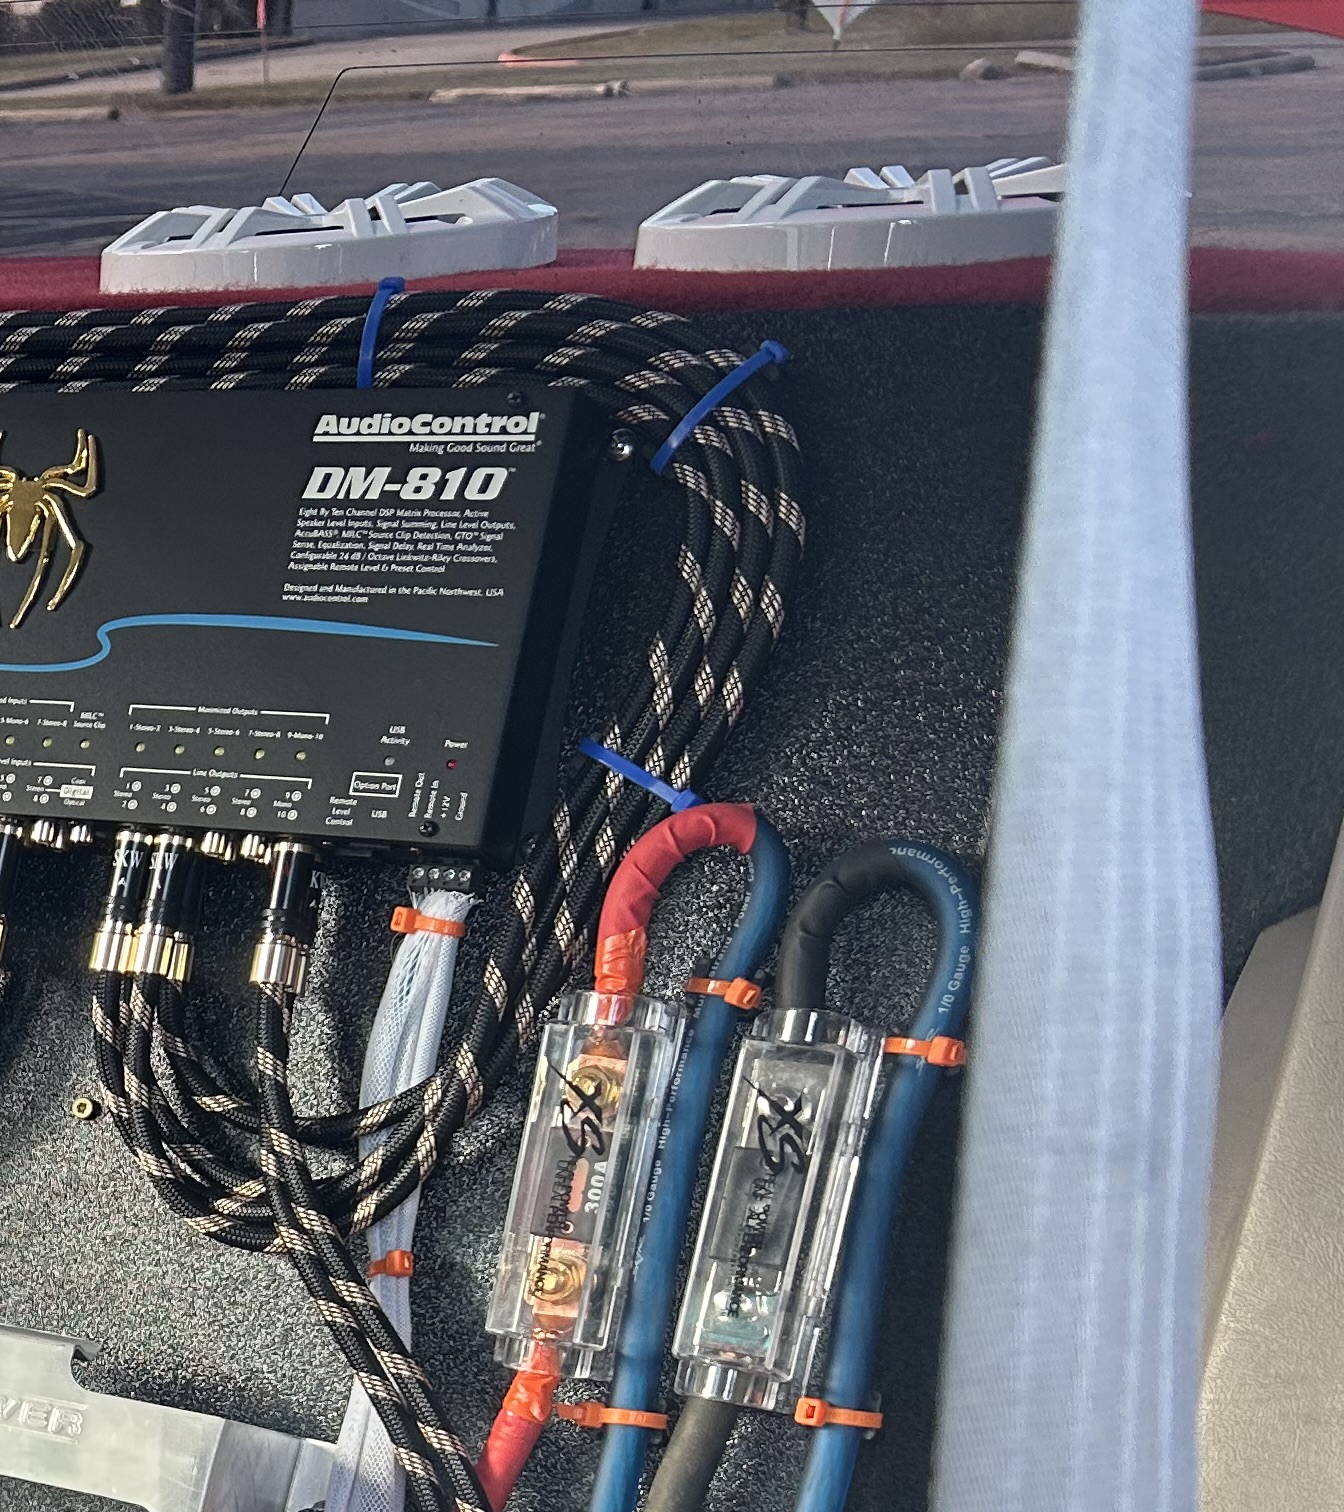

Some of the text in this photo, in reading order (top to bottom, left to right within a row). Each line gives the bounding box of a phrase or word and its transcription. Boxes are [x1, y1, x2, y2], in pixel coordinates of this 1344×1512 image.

[313, 412, 540, 434] AudioControl
[409, 442, 537, 455] Making Good Sound Great
[302, 466, 508, 500] DM-810
[299, 507, 489, 518] Eight By Ten Channel DSP Matrix Processor, Active
[389, 725, 406, 734] USB
[380, 735, 411, 747] Activity
[444, 739, 469, 749] Power
[354, 780, 397, 791] Option Port
[329, 796, 358, 806] Remote
[331, 807, 351, 816] Level
[371, 809, 388, 819] USB
[325, 816, 354, 826] Control
[938, 994, 954, 1013] 1/0
[948, 945, 970, 991] Gauge
[646, 1159, 662, 1200] Gauge
